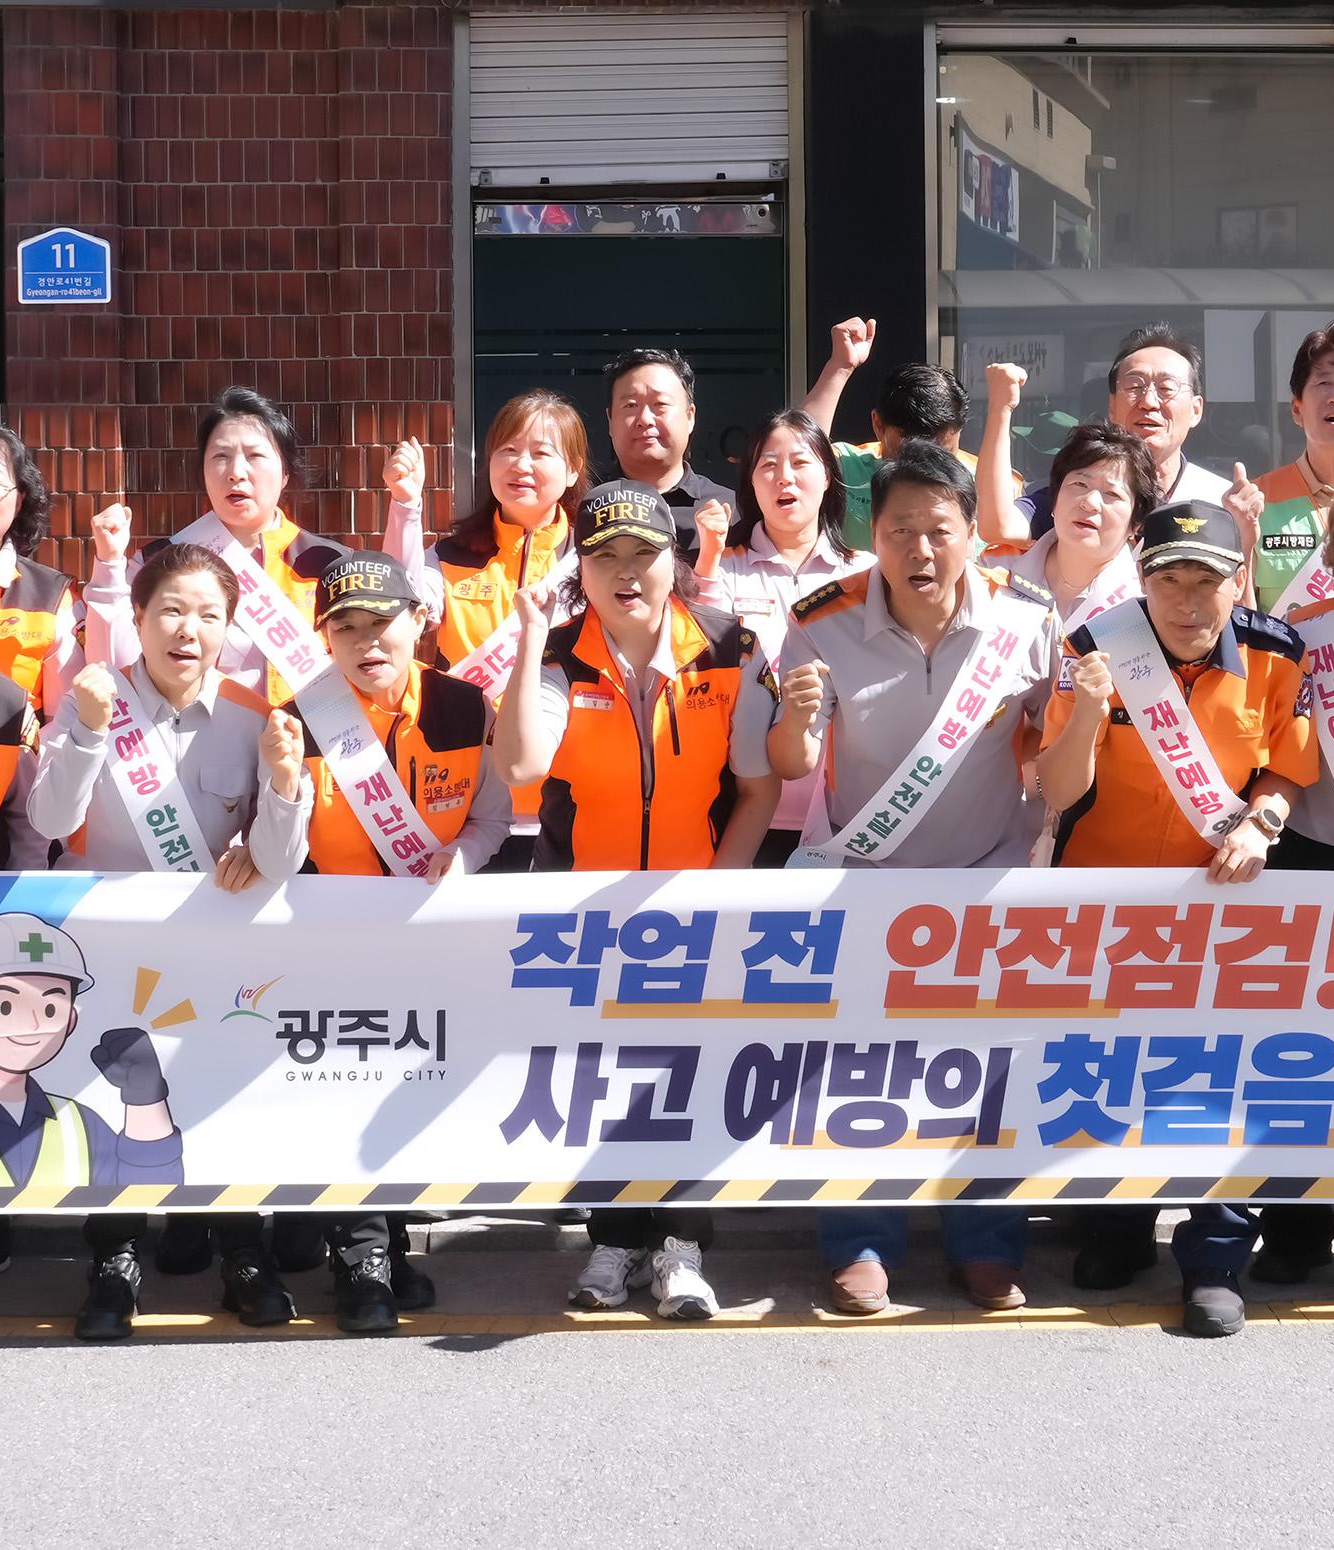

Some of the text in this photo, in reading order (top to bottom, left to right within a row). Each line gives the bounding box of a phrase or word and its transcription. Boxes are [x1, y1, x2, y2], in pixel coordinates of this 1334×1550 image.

[51, 243, 76, 268] 11
[586, 489, 658, 513] VOLUNTEER
[593, 502, 651, 528] FIRE
[1265, 535, 1315, 548] 광주시방재단
[322, 560, 392, 588] VOLUNTEER
[328, 573, 384, 602] FIRE
[459, 583, 492, 597] 광주
[236, 568, 315, 675] 재난예방
[844, 625, 1019, 857] 재난예방 안전실천
[1142, 699, 1224, 815] 재난예방
[108, 698, 202, 872] 난예방 안전
[509, 909, 718, 1007] 작업
[740, 909, 846, 1004] 전
[275, 1009, 447, 1065] 광주시
[285, 1069, 448, 1082] GWANGJU CITY
[498, 1041, 702, 1148] 사고
[723, 1040, 1013, 1149] 예방의
